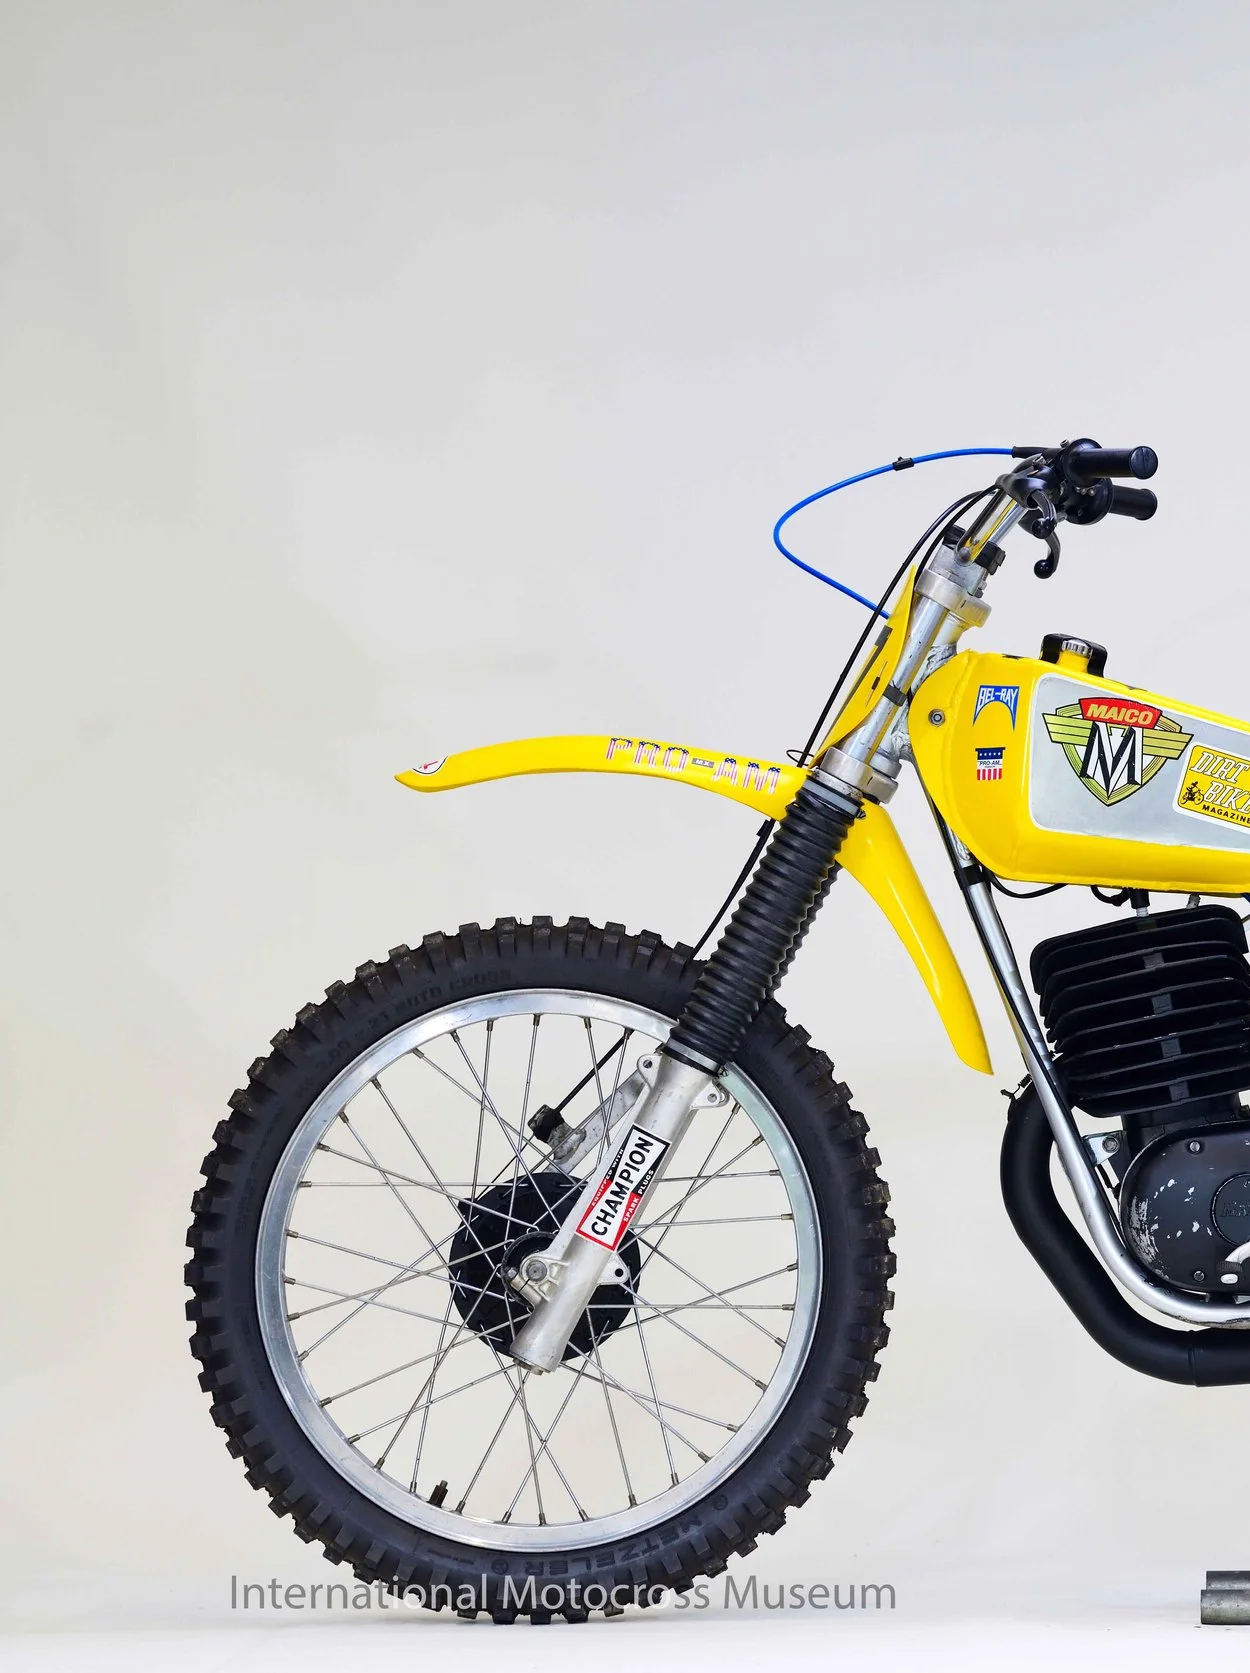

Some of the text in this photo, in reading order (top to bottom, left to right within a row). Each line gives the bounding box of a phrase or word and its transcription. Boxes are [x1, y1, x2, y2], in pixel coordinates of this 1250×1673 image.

[975, 687, 1018, 717] BEL-RAY
[1086, 704, 1154, 726] MAICO
[1080, 720, 1143, 799] M
[1190, 751, 1250, 783] DIRT
[591, 1136, 654, 1236] CHAMPION
[592, 1149, 624, 1205] EQUIPPED WITH
[623, 1170, 654, 1222] SPARK PLUGS
[524, 1514, 700, 1577] METZELER
